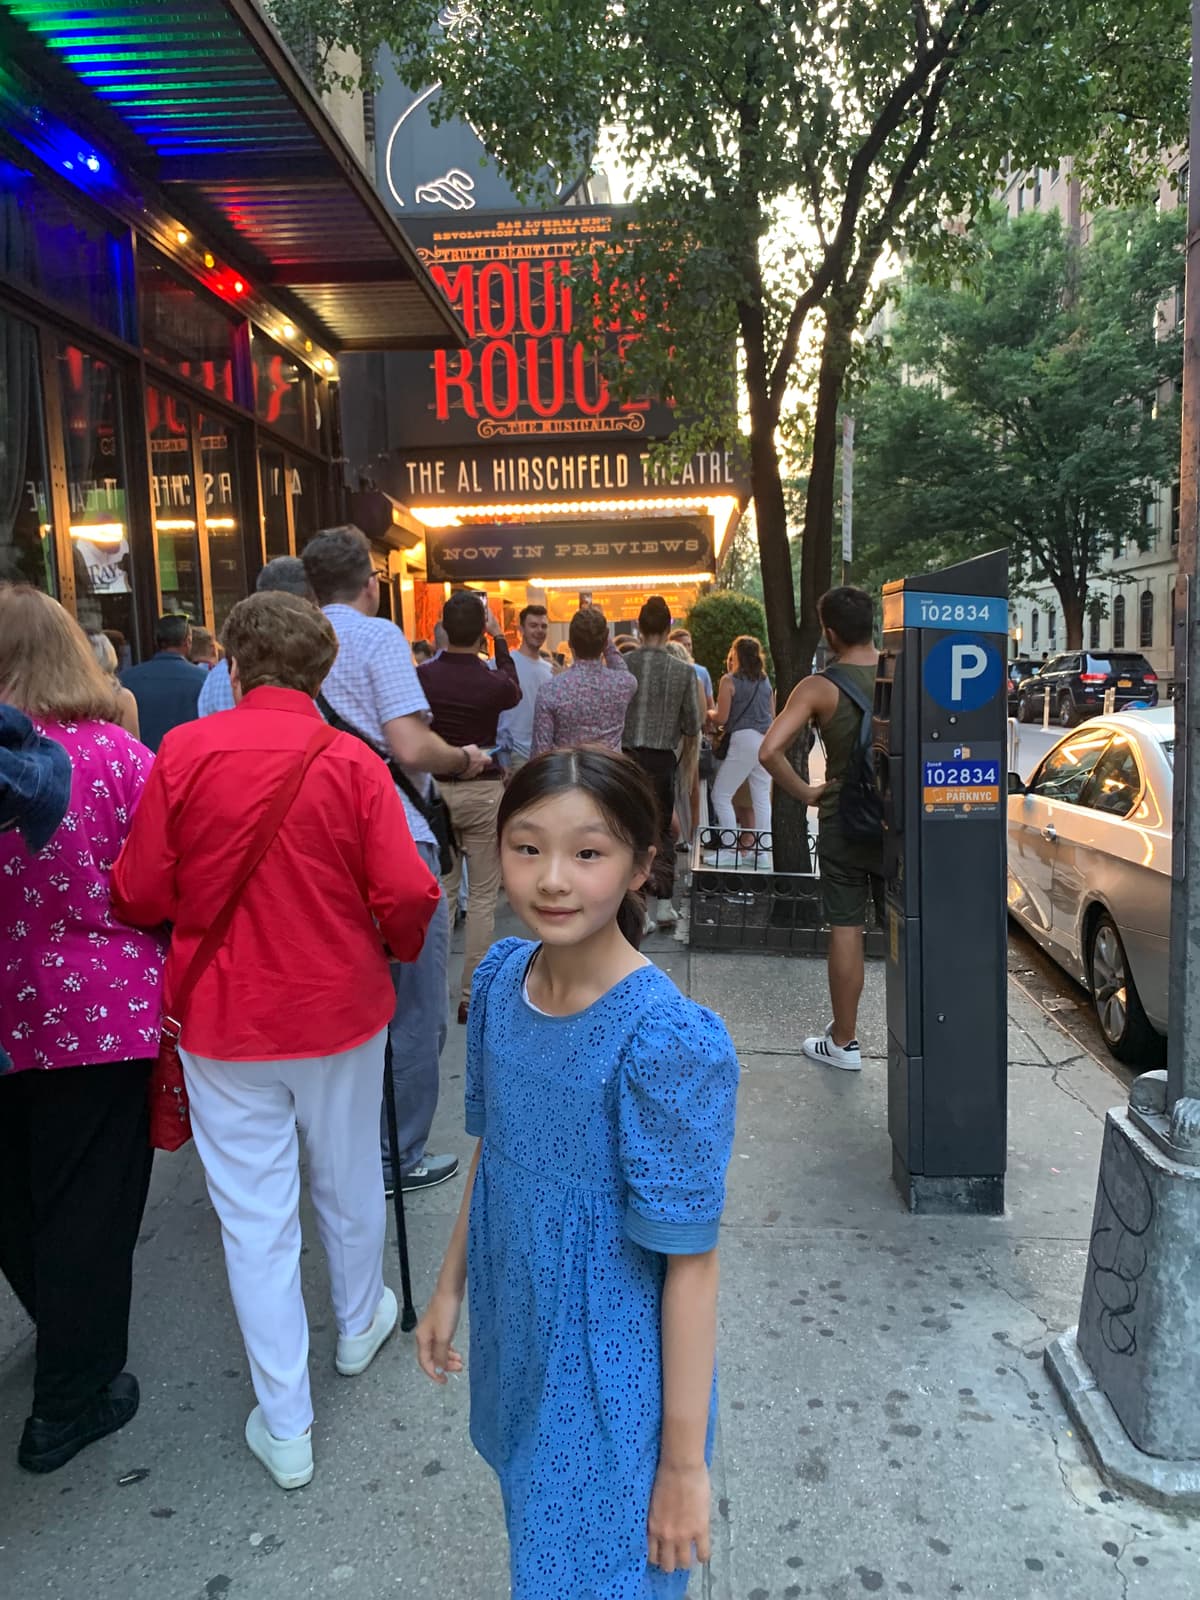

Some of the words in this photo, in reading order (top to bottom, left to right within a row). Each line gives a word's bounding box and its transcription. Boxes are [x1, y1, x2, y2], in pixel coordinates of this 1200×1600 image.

[496, 219, 522, 230] BAS
[433, 227, 540, 241] REVOLUTIONARY
[543, 225, 577, 236] FILM
[440, 248, 487, 260] TRUTH
[499, 244, 550, 257] BEAUTY
[508, 420, 537, 433] THE
[406, 460, 446, 494] THE
[457, 459, 483, 493] AL
[492, 453, 629, 492] HIRSCHFELD
[442, 546, 503, 561] NOW
[512, 545, 545, 559] IN
[554, 539, 700, 556] PREVIEWS
[920, 604, 990, 621] 102834
[951, 644, 988, 701] P
[926, 767, 996, 785] 102834
[946, 791, 992, 801] PARKNYC
